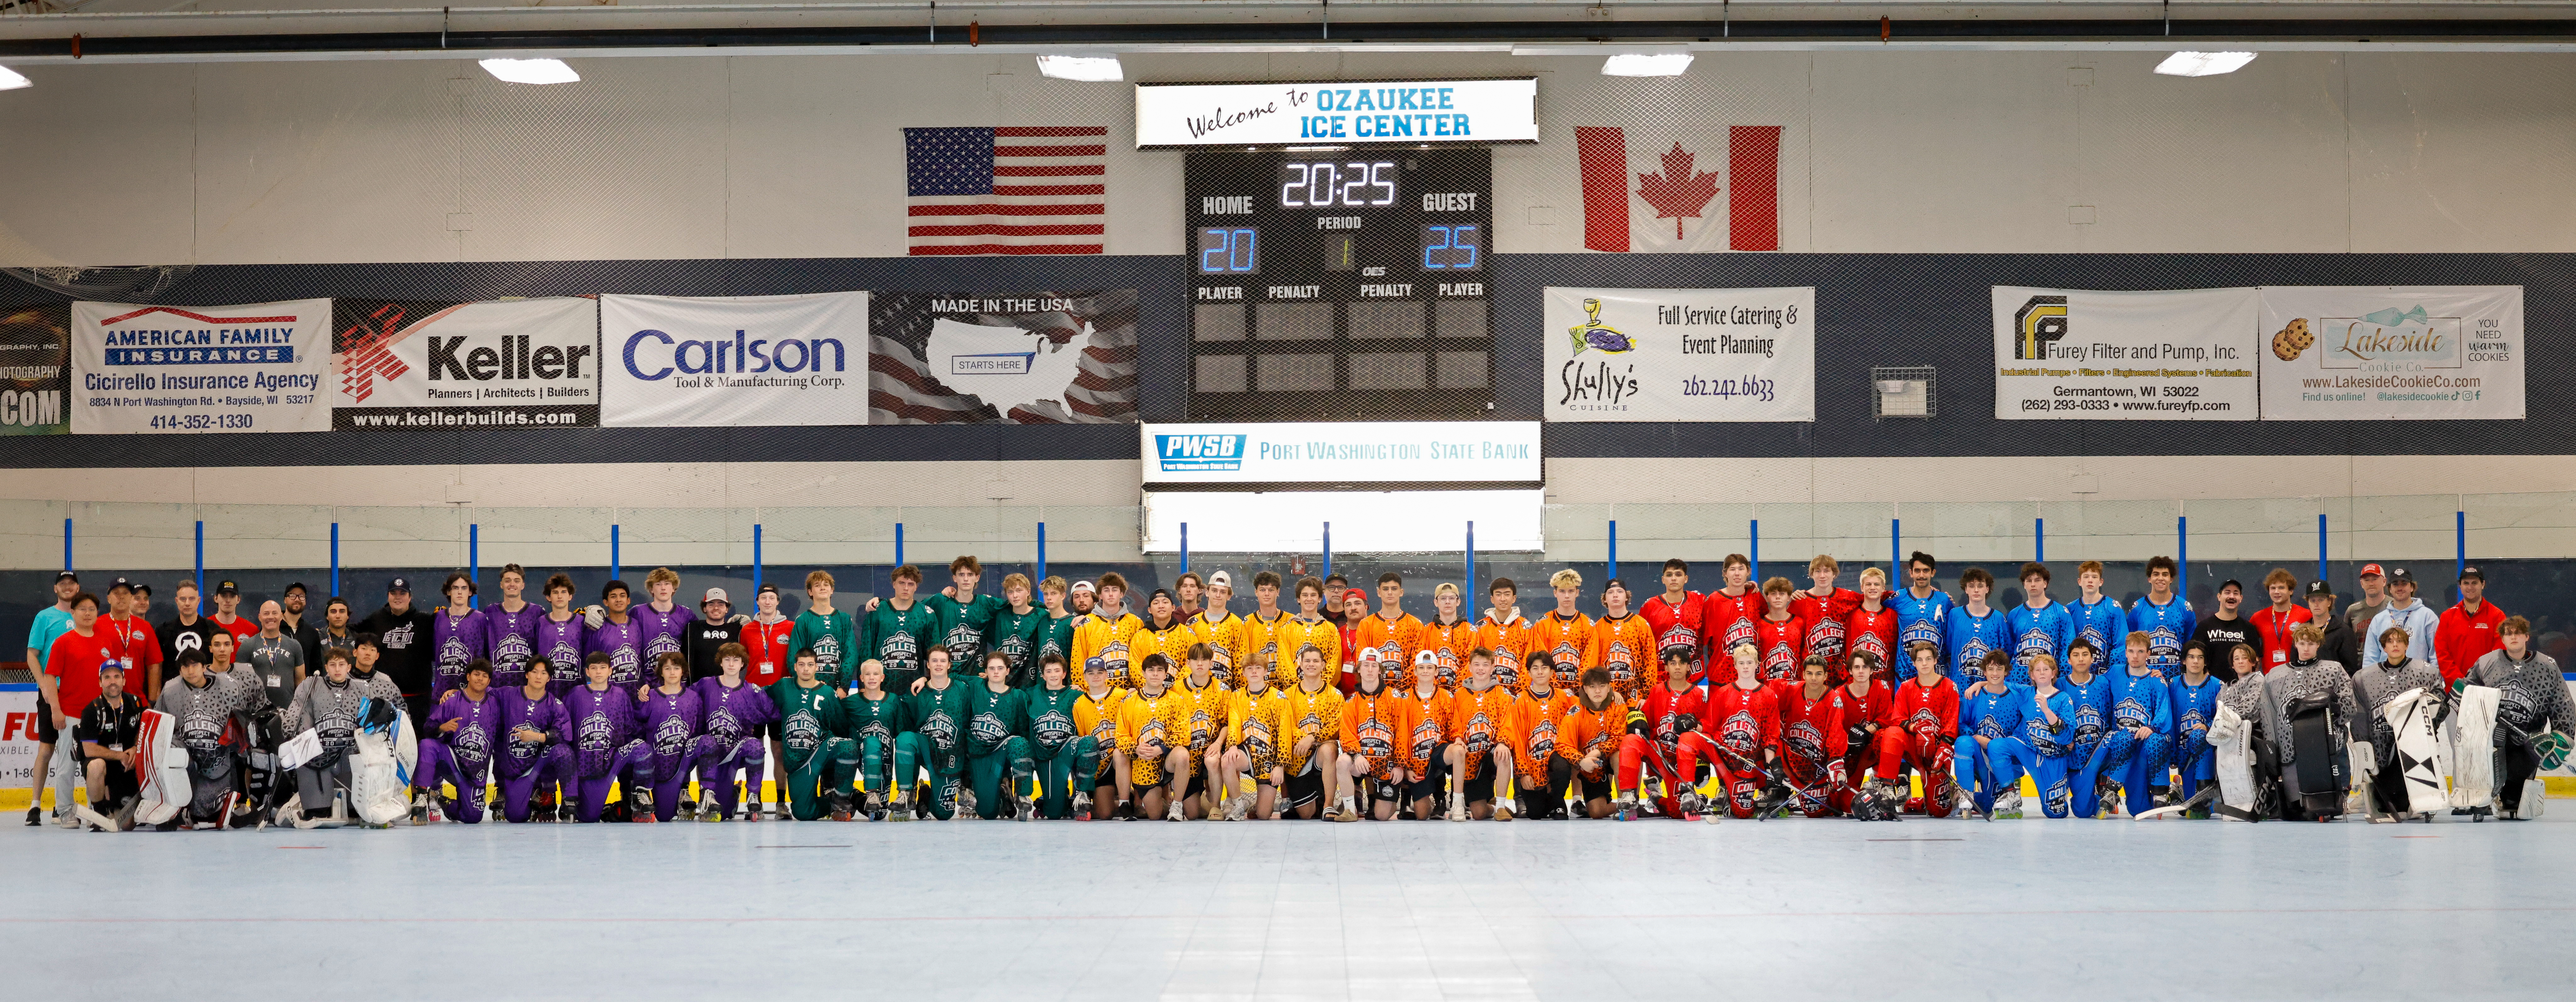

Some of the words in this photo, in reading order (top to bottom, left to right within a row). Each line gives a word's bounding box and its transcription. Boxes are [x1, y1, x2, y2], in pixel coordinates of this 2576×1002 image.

[1317, 88, 1454, 111] OZAUKEE
[1187, 102, 1277, 139] Welcome
[1286, 88, 1308, 107] to
[1301, 116, 1346, 138] ICE
[1355, 114, 1470, 137] CENTER
[1283, 163, 1394, 206] 20:25
[1203, 196, 1253, 214] HOME
[1423, 193, 1477, 211] GUEST
[1318, 217, 1361, 229] PERIOD
[1203, 230, 1254, 271] 20
[1343, 240, 1348, 265] 1
[1425, 226, 1475, 268] 25
[1363, 267, 1385, 276] OES
[1199, 287, 1242, 299] PLAYER
[1269, 285, 1320, 298] PENALTY
[1361, 284, 1412, 297] PENALTY
[1439, 283, 1482, 296] PLAYER
[932, 300, 979, 312] MADE
[984, 300, 1000, 312] IN
[1004, 299, 1036, 312] THE
[1041, 299, 1074, 311] USA
[1658, 305, 1679, 325] Full
[1685, 305, 1726, 325] Service
[1731, 305, 1782, 329] Catering
[1787, 305, 1798, 324] &
[2478, 319, 2498, 328] YOU
[105, 330, 210, 346] AMERICAN
[220, 328, 293, 345] FAMILY
[2335, 322, 2446, 361] Lakeside
[2476, 330, 2501, 339] NEED
[1683, 335, 1715, 354] Event
[1721, 335, 1774, 358] Planning
[2049, 343, 2087, 362] Furey
[2092, 343, 2127, 359] Filter
[2132, 343, 2157, 359] and
[2163, 344, 2208, 361] Pump,
[2214, 344, 2240, 359] Inc.
[2468, 342, 2509, 351] warm
[120, 349, 278, 362] INSURANCE
[428, 335, 590, 381] Keller
[622, 329, 844, 381] Carlson
[2468, 353, 2509, 361] COOKIES
[2041, 368, 2070, 378] Pumps
[2079, 368, 2104, 377] Filters
[2113, 369, 2159, 378] Engineered
[2161, 369, 2197, 378] Systems
[2360, 362, 2401, 372] Cookie
[2407, 362, 2424, 372] Co.
[85, 373, 156, 391] Cicirello
[162, 373, 248, 389] Insurance
[254, 371, 319, 391] Agency
[674, 377, 699, 388] Tool
[704, 377, 714, 387] &
[718, 376, 808, 390] Manufacturing
[811, 375, 844, 390] Corp.
[1560, 360, 1638, 405] Shully's
[1683, 375, 1774, 401] 262.242.6633
[2303, 375, 2480, 388] www.LakesideCookieCo.com
[428, 389, 472, 399] Planners
[484, 388, 535, 397] Architects
[547, 387, 589, 396] Builders
[2053, 386, 2136, 398] Germantown,
[2140, 387, 2156, 396] WI
[2163, 387, 2199, 397] 53022
[2303, 392, 2321, 401] Find
[2336, 392, 2366, 401] online!
[2377, 392, 2449, 401] @lakesidecookie
[1, 390, 60, 427] COM
[89, 397, 111, 407] 8834
[114, 398, 120, 407] N
[123, 397, 141, 407] Port
[144, 396, 198, 408] Washington
[201, 396, 215, 406] Rd.
[226, 396, 264, 407] Bayside,
[267, 395, 278, 405] WI
[286, 395, 314, 404] 53217
[2022, 400, 2050, 412] (262)
[2054, 400, 2109, 410] 293-0333
[2123, 401, 2230, 412] www.fureyfp.com
[150, 414, 253, 429] 414-352-1330
[353, 412, 576, 426] www.kellerbuilds.com
[1166, 436, 1236, 456] PWSB
[1260, 442, 1299, 460] PORT
[1307, 441, 1421, 460] WASHINGTON
[1431, 441, 1475, 459] STATE
[1482, 441, 1528, 459] BANK
[1935, 604, 1944, 622] A
[1659, 635, 1696, 650] COLLEGE
[1810, 628, 1844, 645] COLLEGE
[1903, 631, 1939, 645] COLLEGE
[253, 647, 290, 658] ATHLTE
[497, 645, 532, 660] COLLEGE
[882, 643, 916, 656] COLLEG
[2017, 639, 2052, 655] COLLEGE
[2500, 701, 2521, 710] PROSPECT
[184, 721, 220, 735] OLLEGE
[2421, 706, 2433, 736] CCM
[786, 721, 819, 737] COLLEGE
[1724, 722, 1757, 739] COLLEGE
[136, 722, 145, 753] VAUGHN
[1790, 729, 1822, 749] COLLEGE
[398, 752, 409, 767] BAUER
